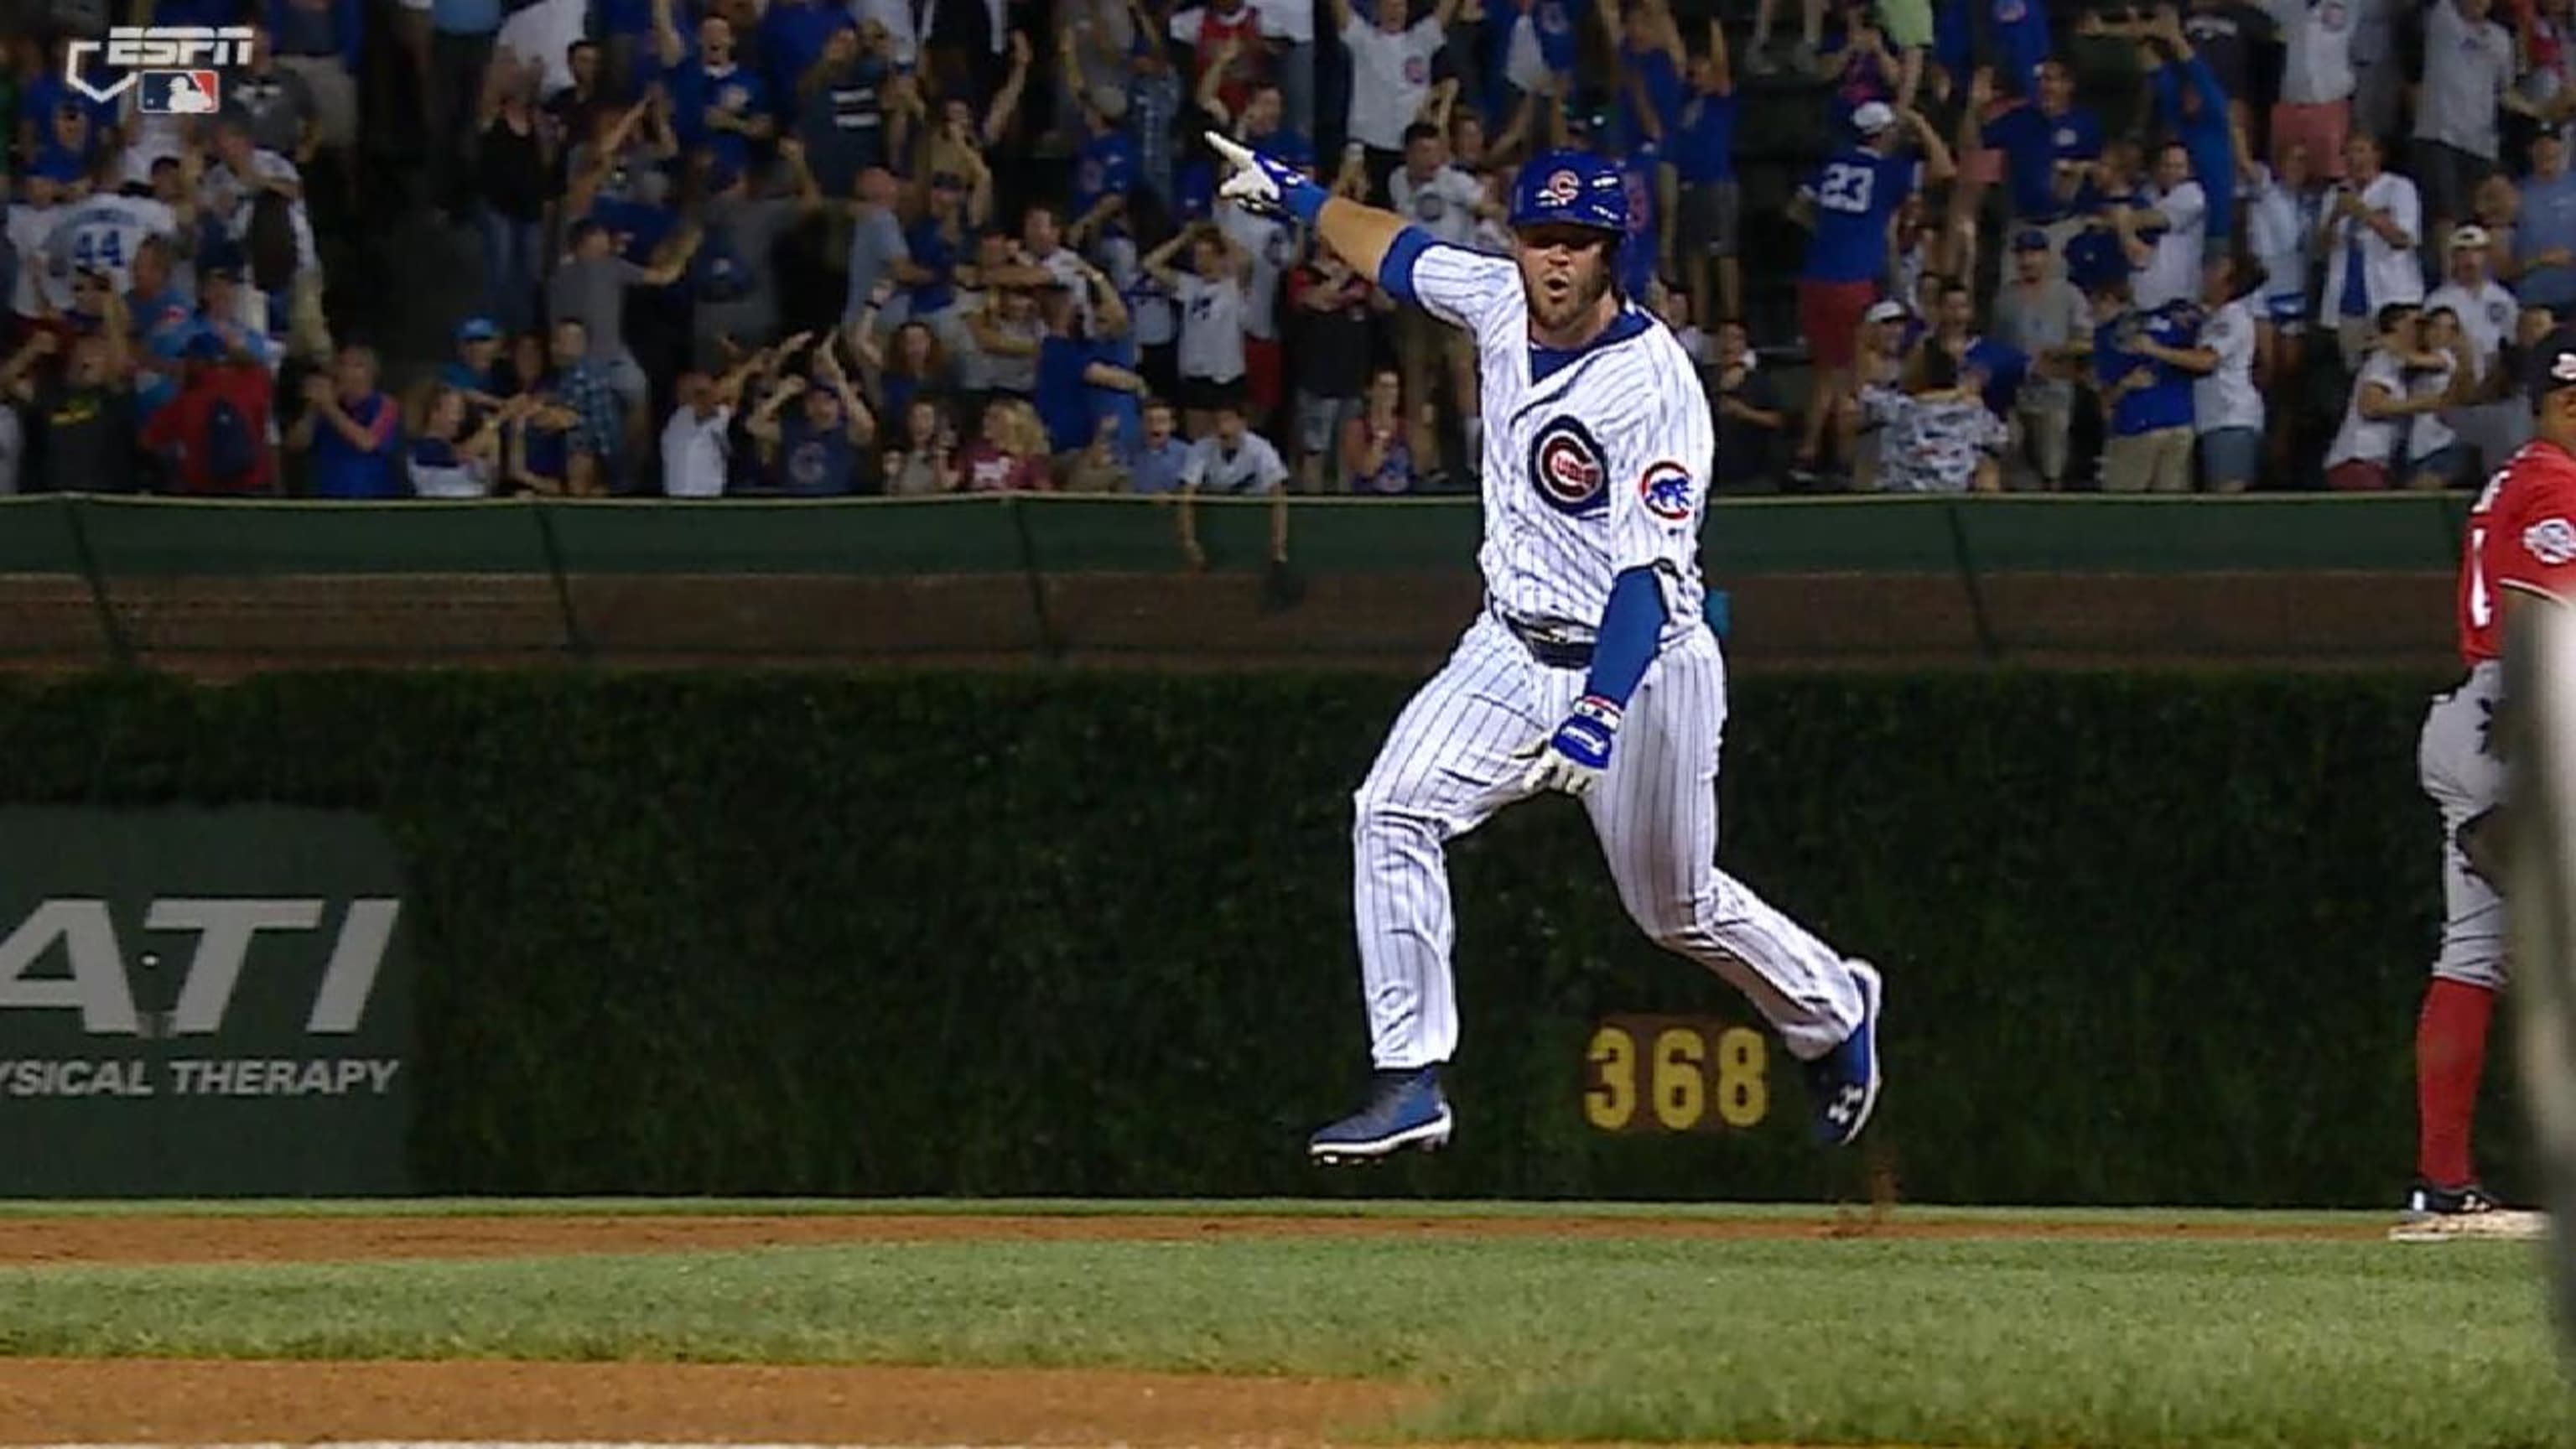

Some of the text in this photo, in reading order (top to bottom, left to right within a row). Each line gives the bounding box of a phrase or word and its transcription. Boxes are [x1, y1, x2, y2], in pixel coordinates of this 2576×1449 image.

[1820, 163, 1874, 213] 23
[0, 899, 401, 1036] ATI
[170, 1059, 400, 1095] THERAPY
[1584, 1026, 1768, 1130] 368
